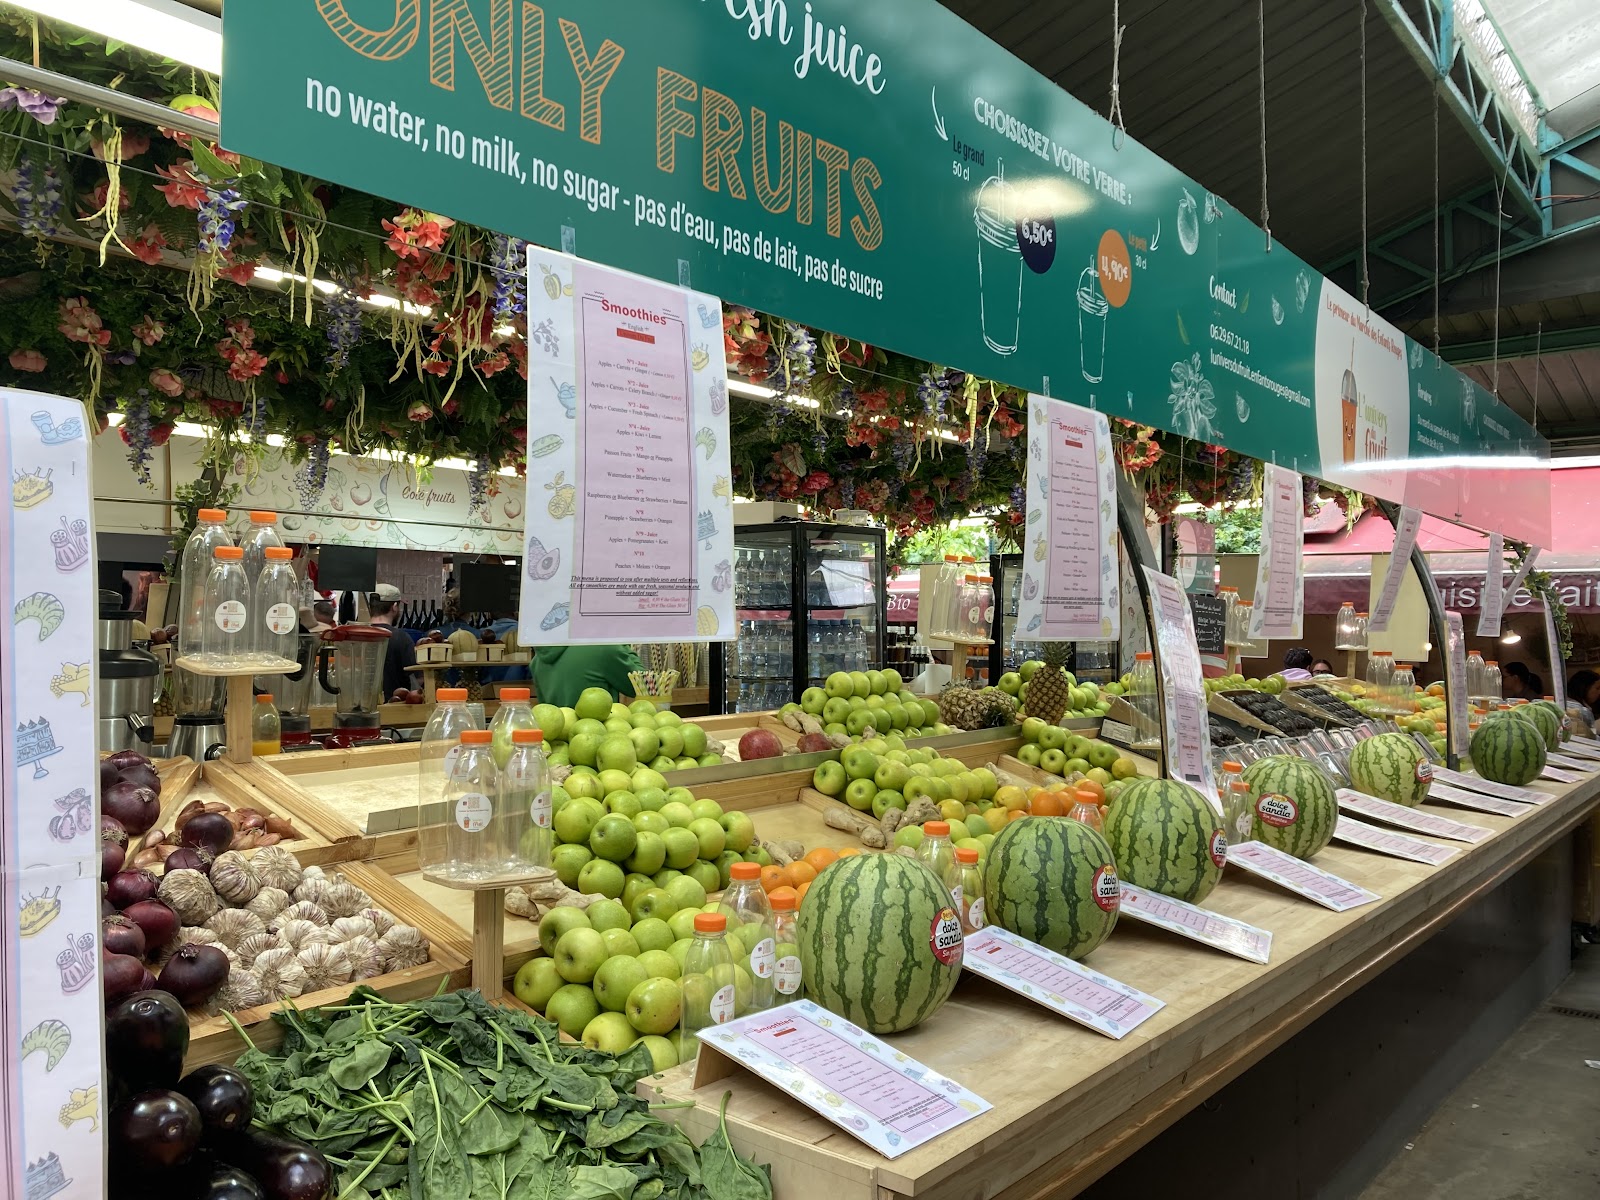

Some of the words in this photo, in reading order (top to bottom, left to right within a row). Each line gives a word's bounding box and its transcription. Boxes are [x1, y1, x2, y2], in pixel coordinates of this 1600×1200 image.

[794, 2, 886, 95] juice
[657, 66, 883, 250] FRUITS
[953, 135, 961, 154] Le
[963, 143, 984, 166] grand
[974, 97, 1050, 161] CHOISISSEZ
[1052, 142, 1090, 184] VOTRE
[1092, 167, 1126, 205] VERRE
[952, 160, 961, 178] 50
[963, 166, 970, 181] cl
[307, 77, 341, 117] no
[349, 92, 429, 152] water,
[436, 123, 465, 159] no
[472, 135, 526, 184] milk,
[533, 158, 558, 190] no
[563, 169, 619, 212] sugar
[635, 194, 666, 226] pas
[670, 201, 720, 249] d'eau,
[724, 225, 750, 255] pas
[754, 231, 771, 263] de
[775, 237, 801, 276] lait,
[805, 254, 828, 282] pas
[831, 259, 846, 288] de
[850, 270, 882, 300] sucre
[1022, 218, 1053, 247] 6,50€
[1102, 256, 1128, 282] 4,90€
[1210, 275, 1237, 309] Contact
[602, 299, 666, 325] Smoothies
[628, 323, 643, 332] English
[1210, 324, 1250, 354] 06.29.67.21.18
[1059, 422, 1086, 435] Smoothies
[426, 488, 456, 506] fruits
[1268, 800, 1288, 810] dolce
[942, 921, 958, 933] dolce
[754, 1019, 793, 1033] Smoothies
